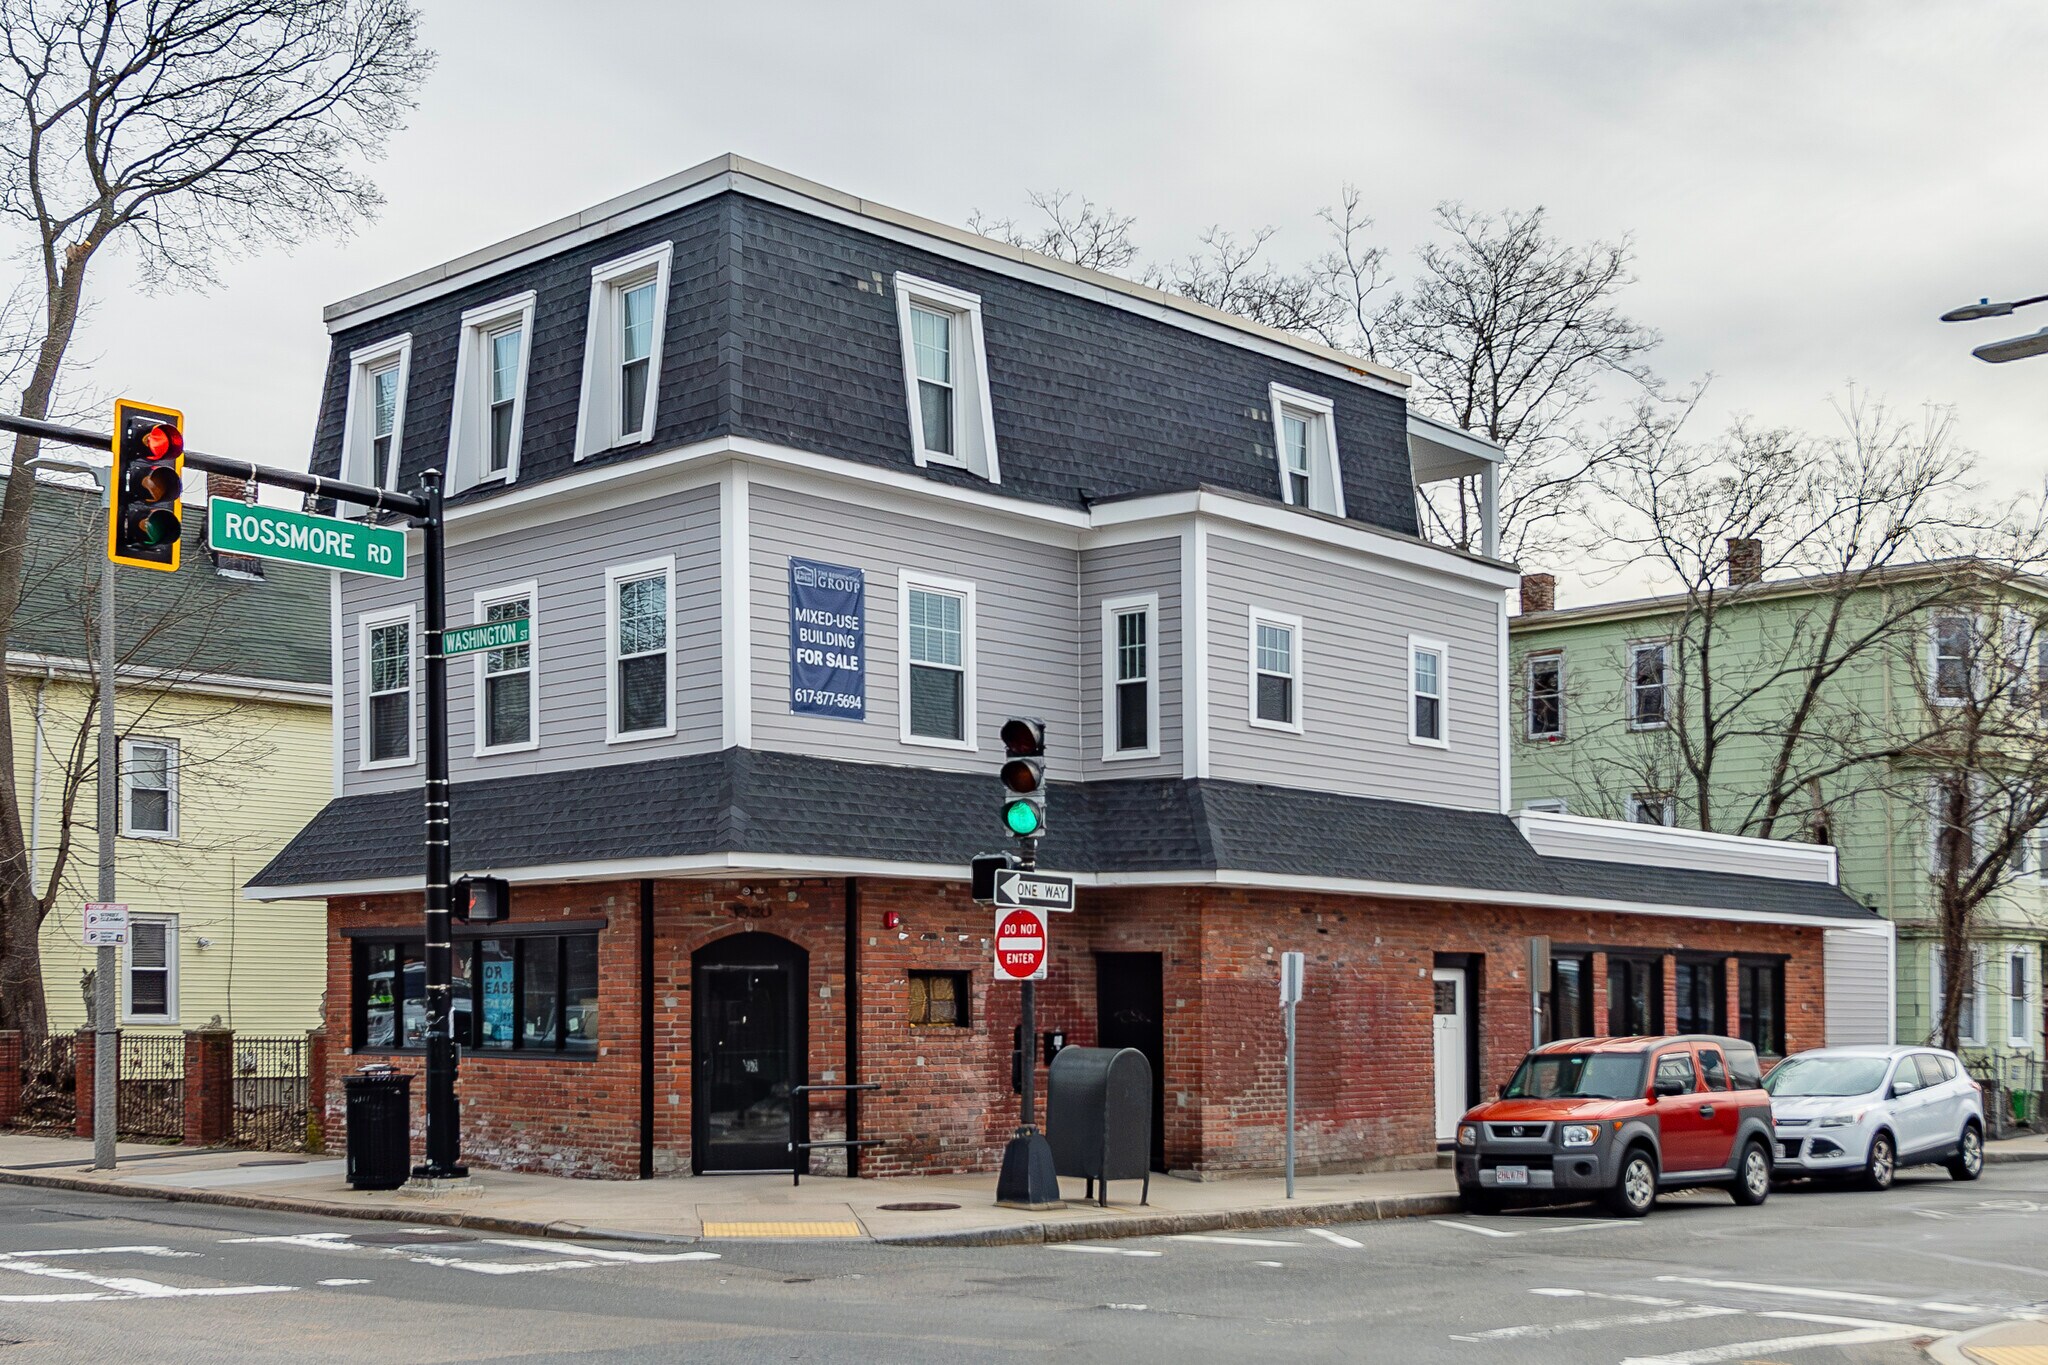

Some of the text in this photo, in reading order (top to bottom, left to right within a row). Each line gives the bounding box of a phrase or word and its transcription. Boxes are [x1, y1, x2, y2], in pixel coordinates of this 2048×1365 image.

[225, 512, 392, 565] ROSSMORE RD
[817, 576, 860, 593] GROUP
[795, 607, 859, 630] MIXED-USE
[446, 623, 528, 653] WASHINGTON ST
[800, 628, 855, 648] BUILDING
[797, 648, 858, 671] FOR SALE
[795, 688, 861, 709] 617-877-5694
[1017, 883, 1067, 899] ONE WAY
[1004, 924, 1037, 935] DO NOT
[1006, 953, 1034, 965] ENTER
[485, 966, 502, 979] OR
[485, 981, 514, 995] EASE
[1442, 1017, 1447, 1029] 2
